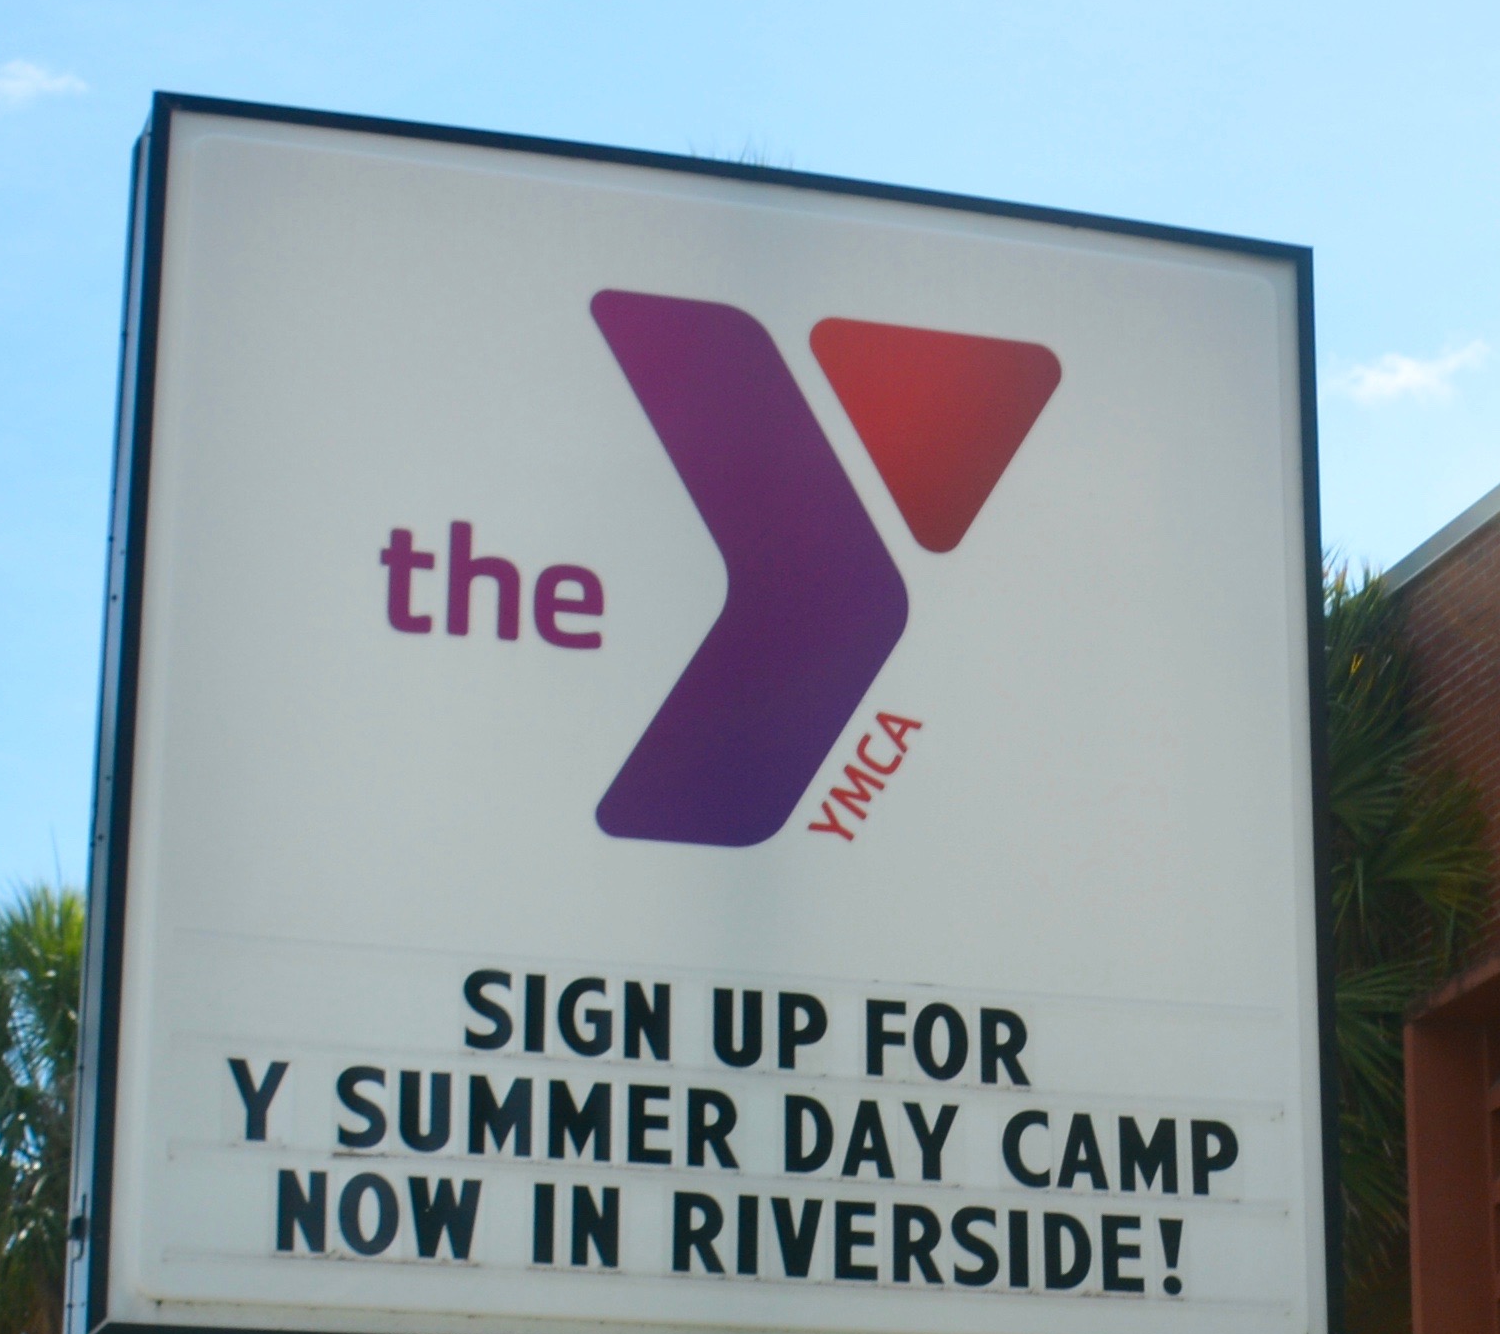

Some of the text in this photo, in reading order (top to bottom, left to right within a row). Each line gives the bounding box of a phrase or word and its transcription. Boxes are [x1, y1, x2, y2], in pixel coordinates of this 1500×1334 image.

[380, 289, 1062, 849] the Y
[807, 710, 923, 843] YMCA
[462, 968, 1032, 1088] SIGN UP FOR
[226, 1056, 1240, 1197] Y SUMMER DAY CAMP
[275, 1168, 1186, 1297] NOW IN RIVERSIDE!
